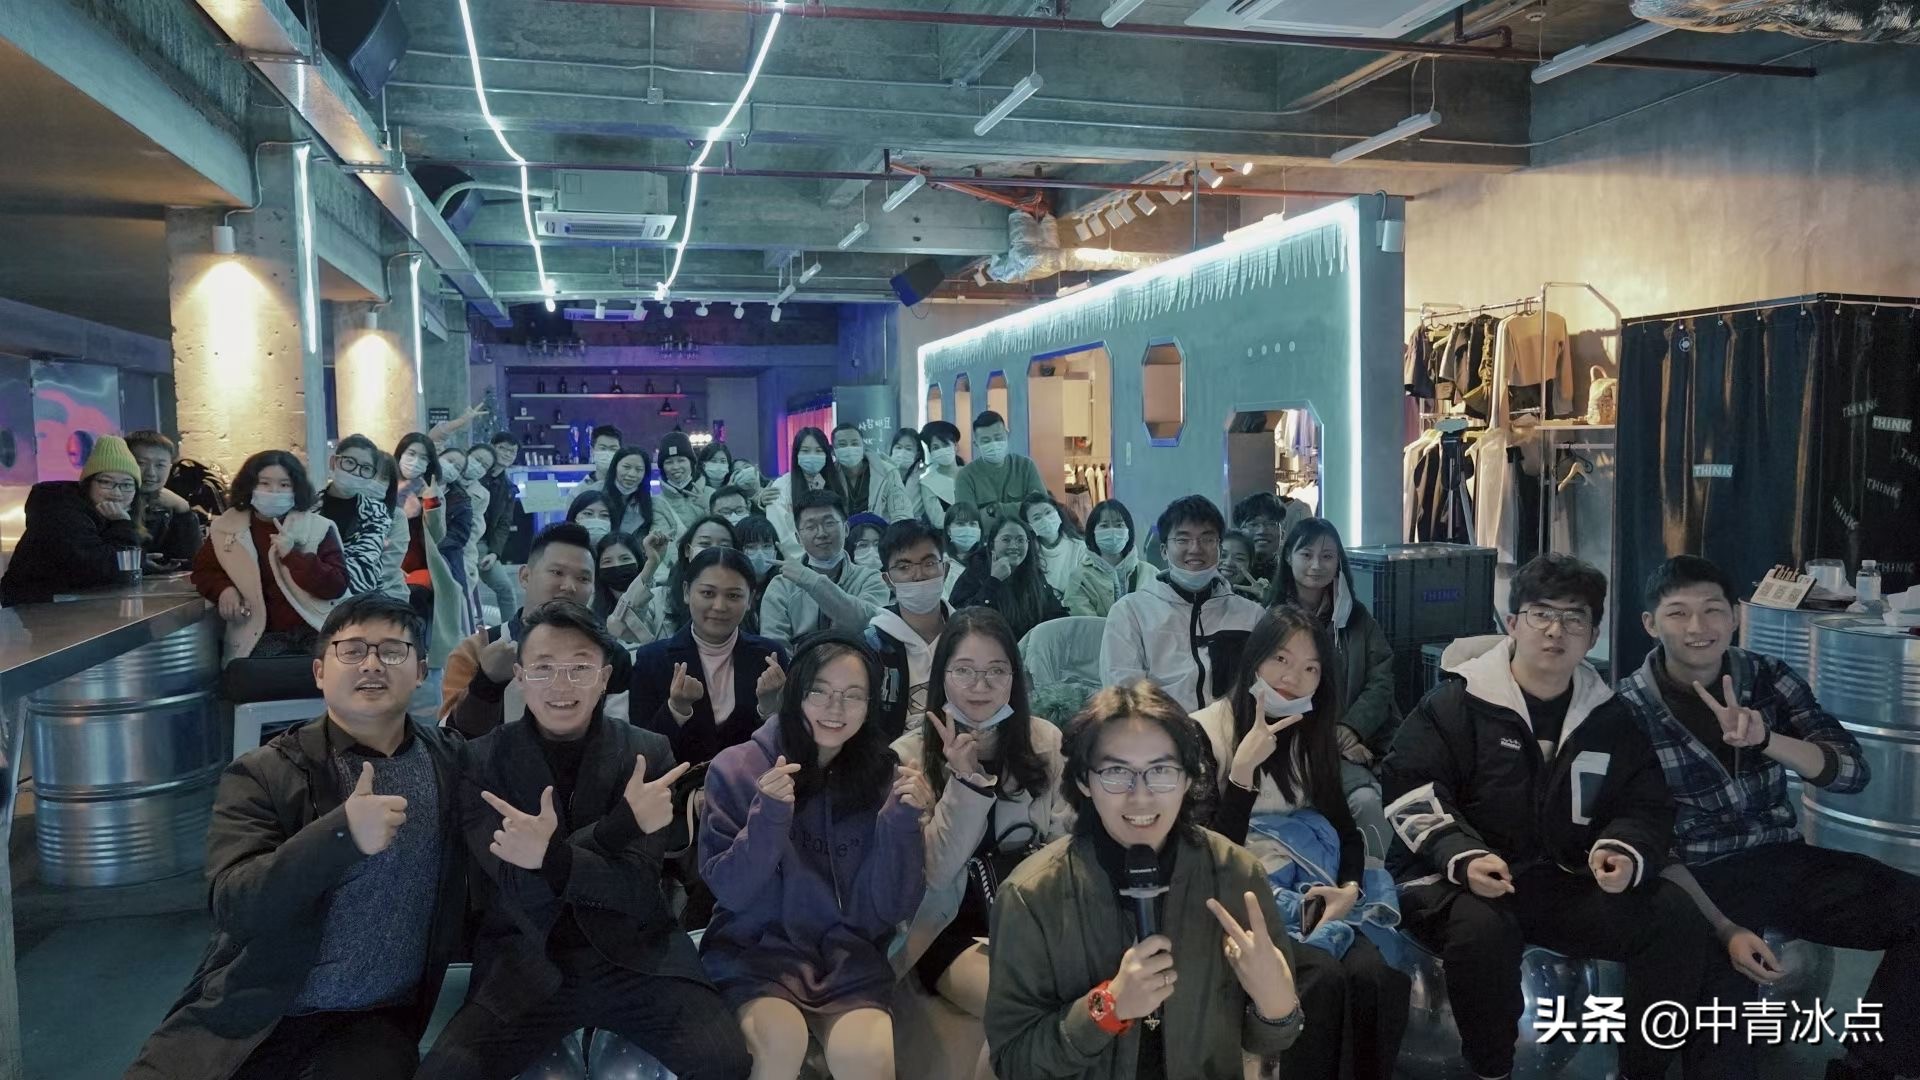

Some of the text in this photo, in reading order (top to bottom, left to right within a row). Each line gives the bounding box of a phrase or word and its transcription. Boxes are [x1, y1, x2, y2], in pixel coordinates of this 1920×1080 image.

[1873, 416, 1912, 432] THINK
[1901, 447, 1920, 468] THI
[1693, 464, 1733, 477] THINK
[1866, 478, 1902, 499] THINK
[1833, 496, 1859, 530] THINK
[1773, 564, 1800, 583] Think
[1876, 562, 1915, 573] THINK
